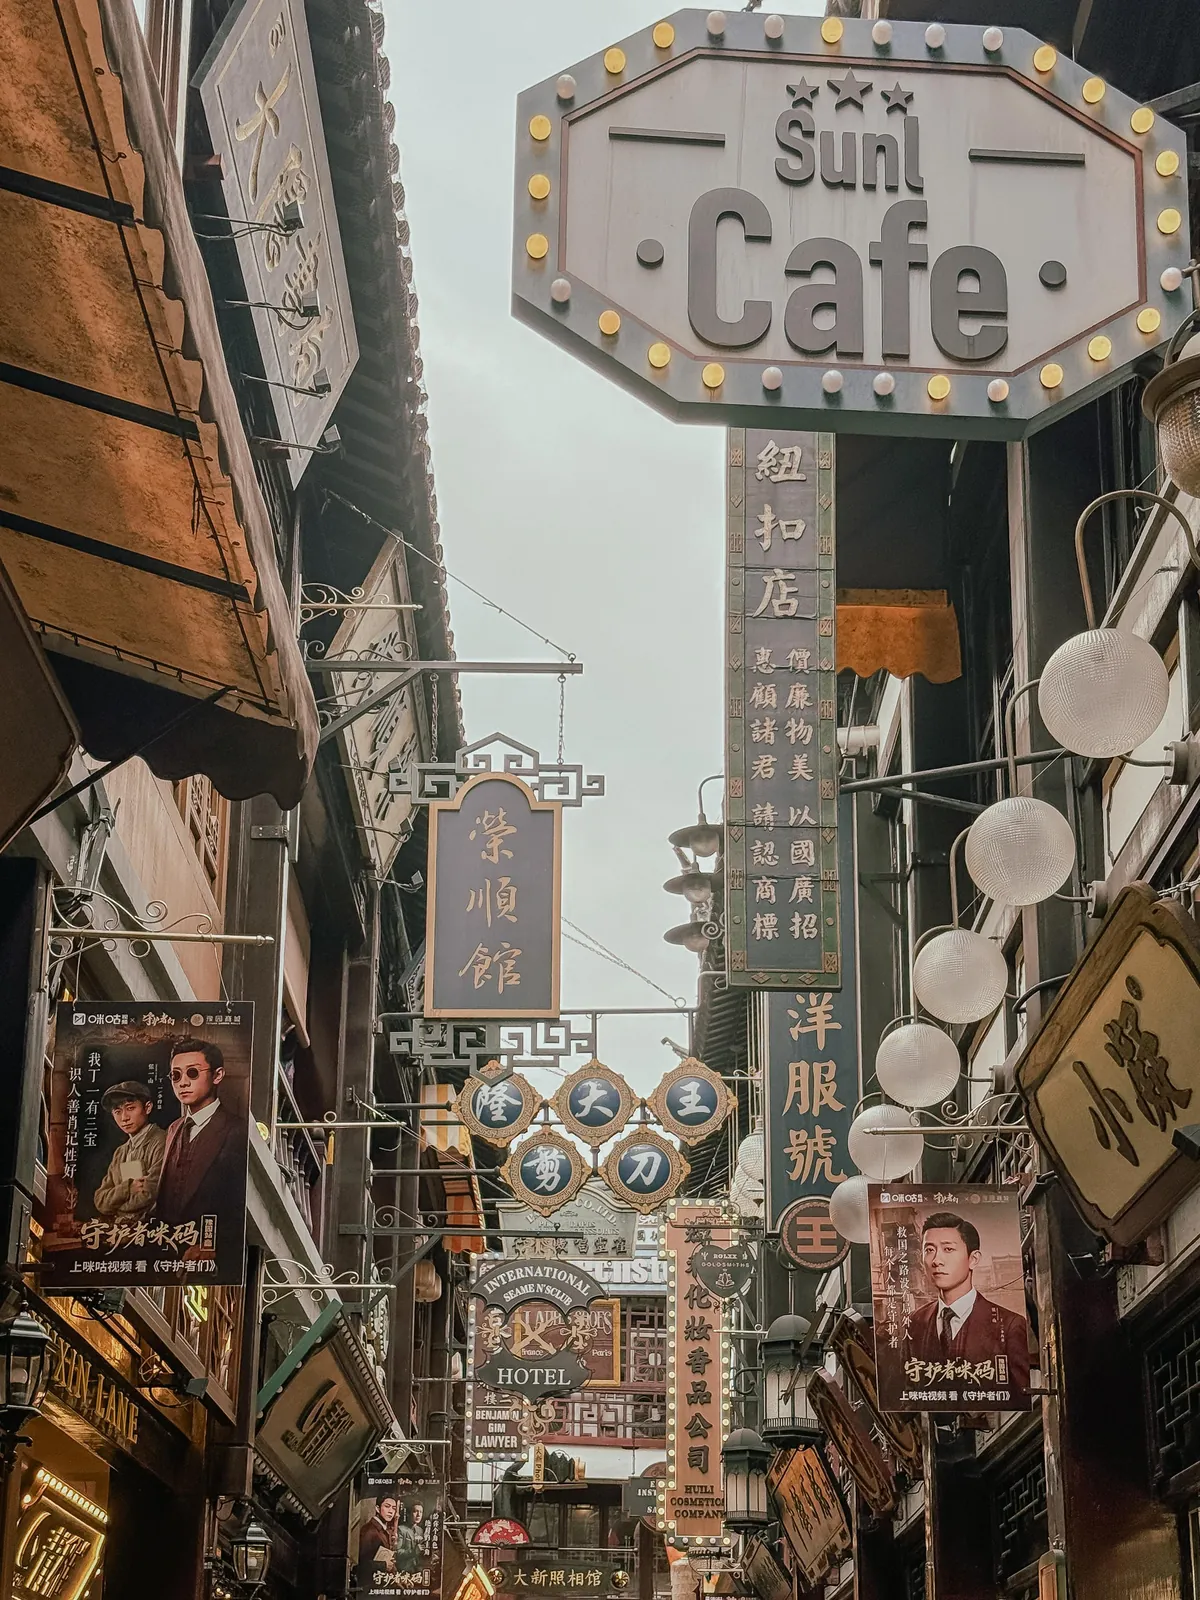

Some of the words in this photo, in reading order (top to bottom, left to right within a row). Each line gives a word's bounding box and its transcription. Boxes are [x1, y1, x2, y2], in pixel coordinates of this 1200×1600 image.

[775, 107, 925, 194] Sunl
[687, 187, 1009, 362] Cafe
[755, 439, 807, 618] 紐扣店
[748, 646, 779, 780] 惠顧諸君
[784, 648, 815, 782] 價廉物美
[750, 801, 780, 941] 請認商標
[459, 807, 522, 995] 榮順館
[84, 1052, 101, 1148] 我丁一有三宝
[782, 992, 848, 1186] 洋服號
[796, 1216, 838, 1254] 王
[69, 1260, 132, 1273] 上咪咕视频
[135, 1260, 147, 1273] 看
[152, 1260, 217, 1273] 《守护者们》
[483, 1265, 591, 1296] INTERNATIONAL
[591, 1349, 612, 1357] Paris
[497, 1368, 571, 1385] HOTEL
[95, 1373, 139, 1444] LANE
[900, 1390, 947, 1401] 上咪咕视频
[949, 1390, 958, 1401] 看
[962, 1390, 1011, 1402] 《守护者们》
[475, 1410, 520, 1420] BENJAMN
[488, 1423, 506, 1433] GIM
[475, 1435, 518, 1448] LAWYER
[637, 1488, 656, 1497] INST
[684, 1485, 714, 1494] HUILI
[674, 1509, 726, 1518] COMPANY
[513, 1568, 603, 1587] 大新照相馆
